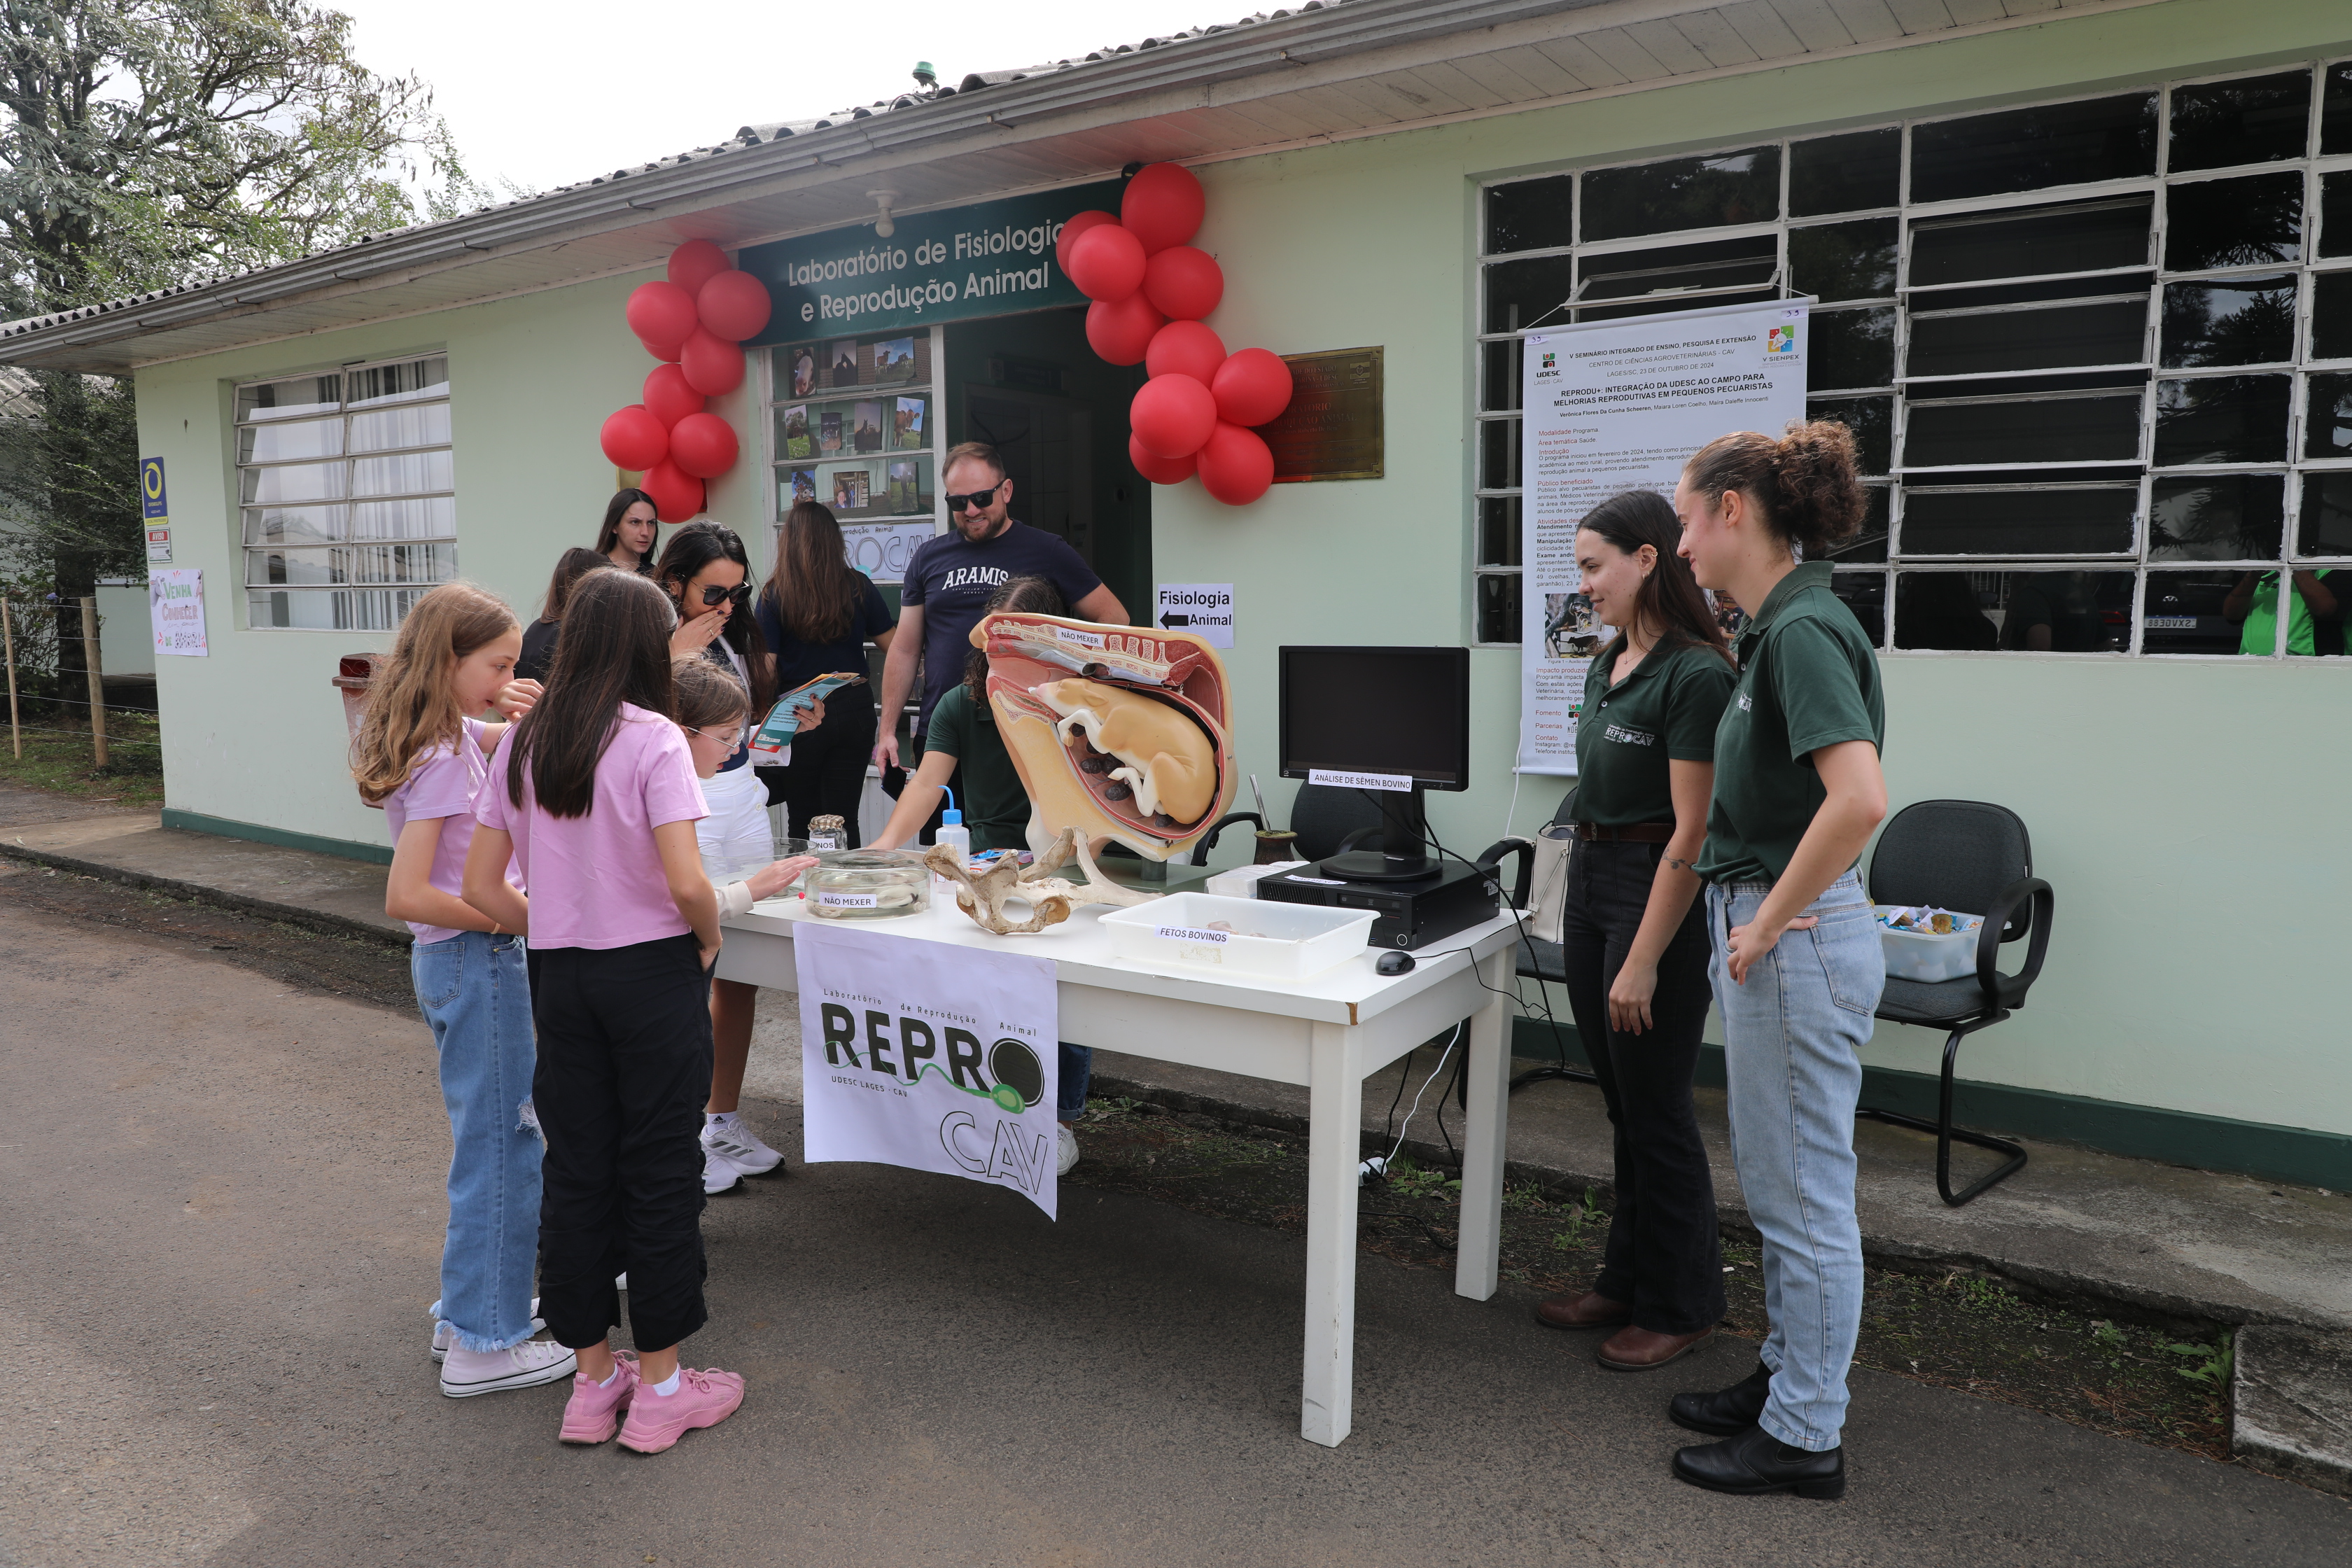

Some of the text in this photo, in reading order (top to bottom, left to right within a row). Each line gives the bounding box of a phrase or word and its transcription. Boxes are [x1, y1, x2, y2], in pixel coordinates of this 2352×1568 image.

[788, 246, 907, 287] Laboratório
[914, 239, 946, 265] de
[801, 262, 1049, 322] e Reprodução Animal
[1575, 350, 1607, 358] SEMINÁRIO
[1722, 335, 1756, 344] EXTENSÃO
[1589, 359, 1613, 368] CENTRO
[1653, 351, 1716, 361] AGROVETERINÁRIAS
[1554, 398, 1596, 406] MELHORIAS
[1599, 392, 1656, 402] REPRODUTIVAS
[1672, 387, 1714, 396] PEQUENOS
[1717, 382, 1772, 393] PECUARISTAS
[1561, 388, 1603, 397] REPRODU+:
[1606, 382, 1655, 393] INTEGRAÇÃO
[1712, 375, 1740, 384] CAMPO
[153, 532, 164, 540] AVISO
[843, 526, 869, 535] produção
[942, 567, 1008, 590] ARAMIS
[163, 582, 192, 599] VENHA
[1161, 591, 1229, 608] Fisiologia
[162, 603, 198, 621] CONHECER
[1190, 614, 1231, 625] Animal
[165, 636, 172, 646] DE
[1061, 630, 1099, 645] NÃO MEXER
[1605, 727, 1654, 746] REPROCAV
[1315, 773, 1343, 783] ANÁLISE
[1356, 776, 1380, 787] SÊMEN
[1382, 780, 1410, 789] BOVINO
[1161, 928, 1226, 942] FETOS BOVINOS
[824, 988, 882, 1005] Laboratório
[918, 1005, 976, 1024] Reprodução
[1000, 1022, 1036, 1037] Animal
[820, 1002, 1044, 1108] REPRO
[832, 1075, 907, 1098] UDESC LAGES CAV
[940, 1110, 1048, 1195] CAV
